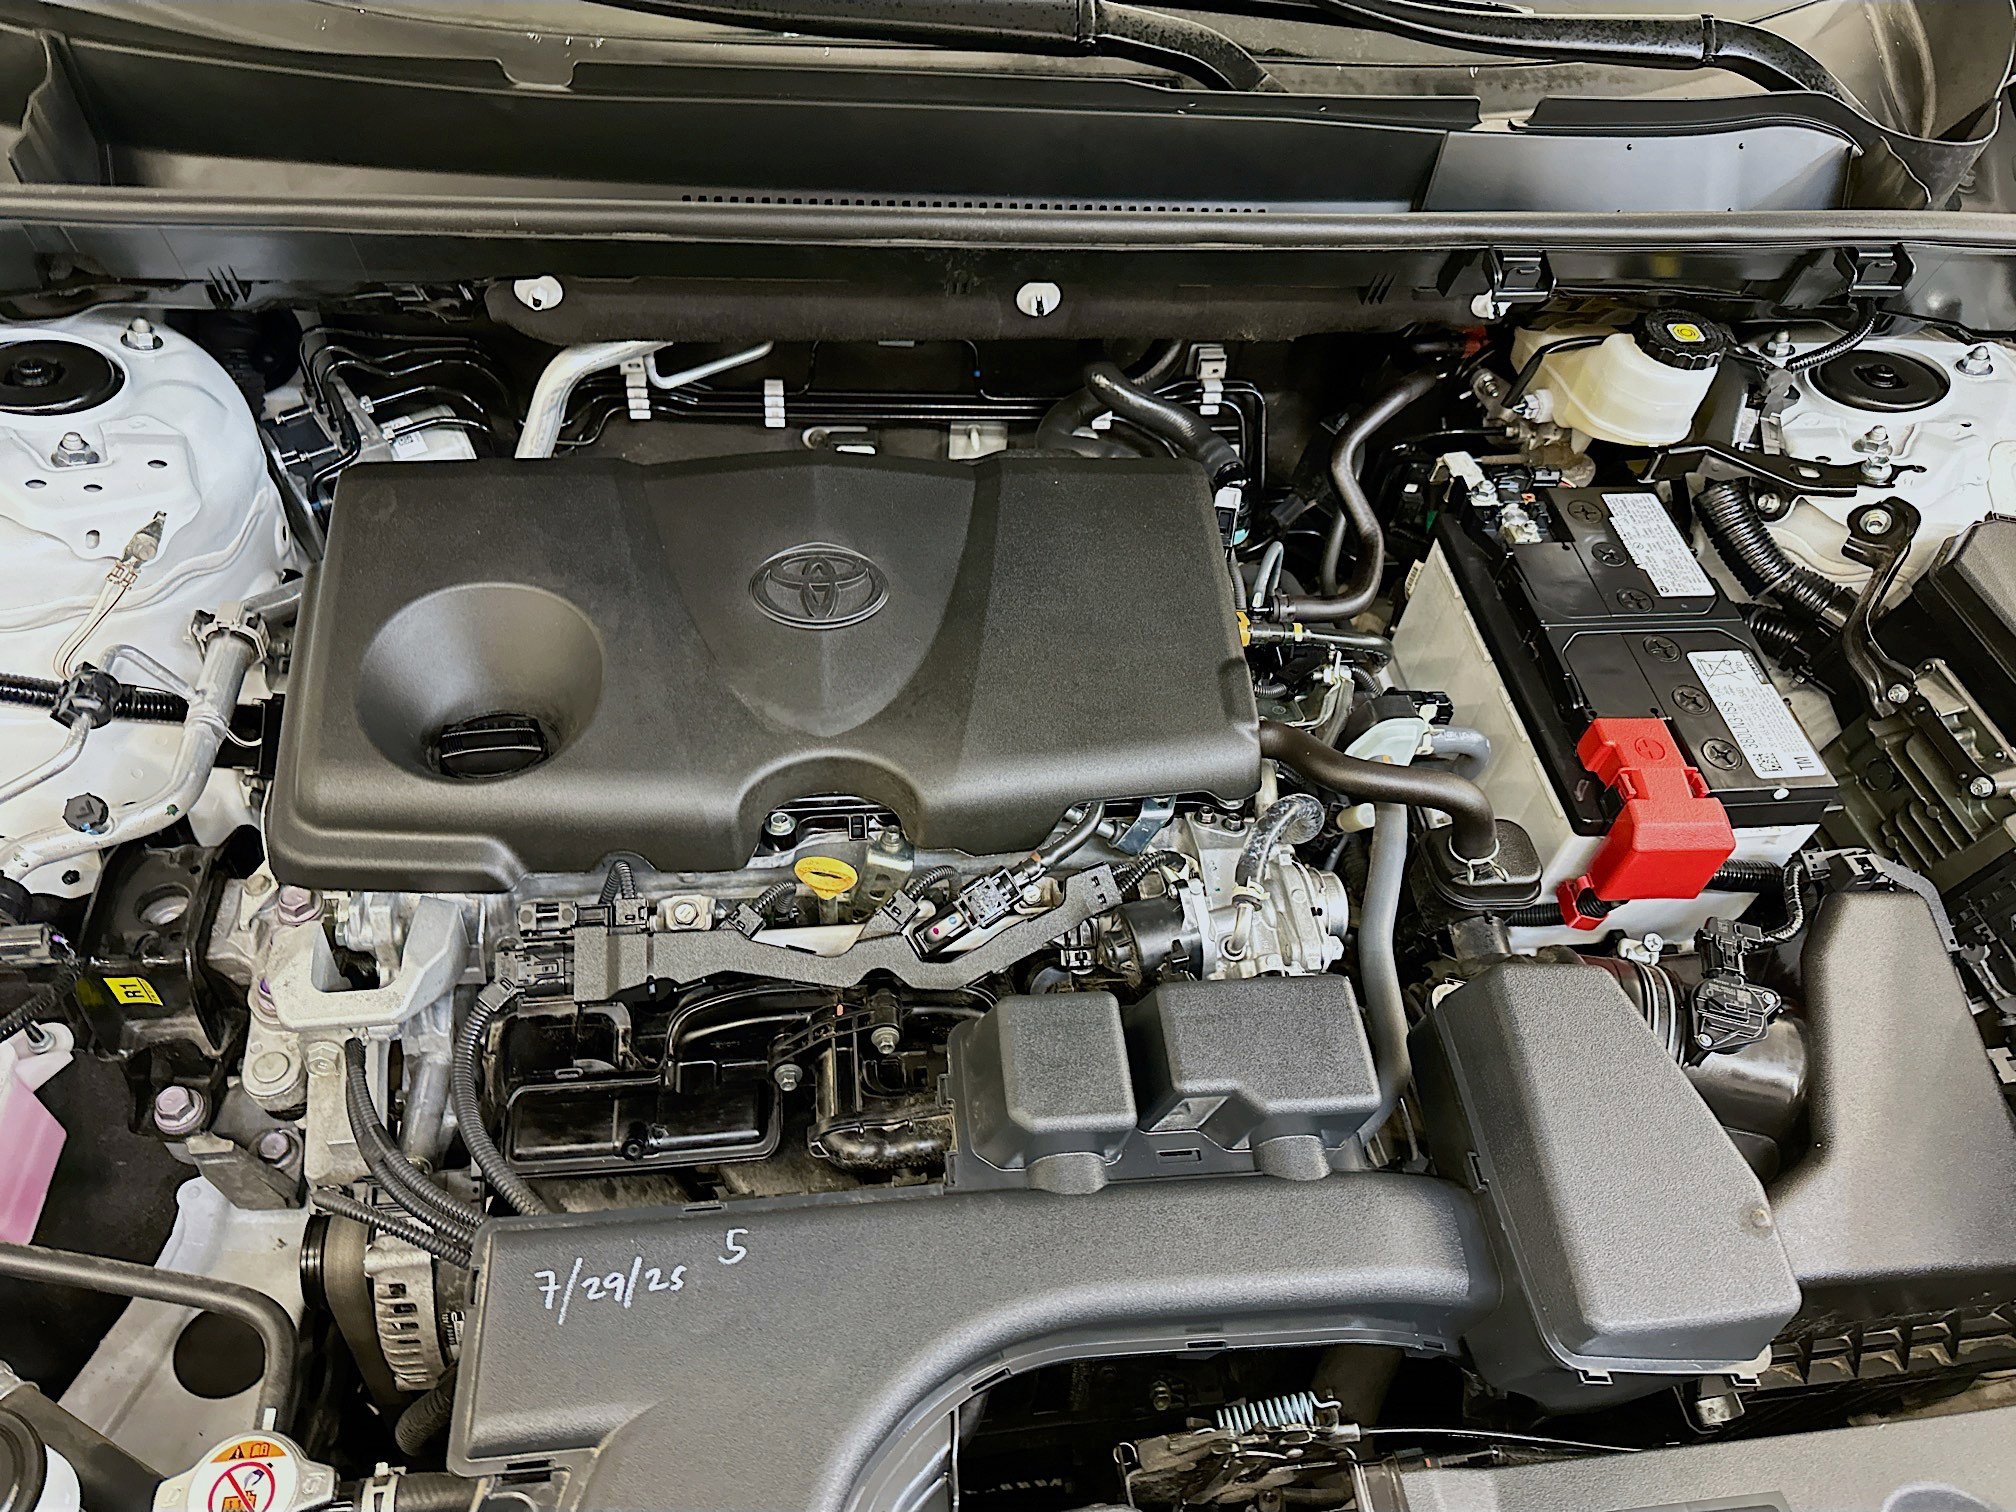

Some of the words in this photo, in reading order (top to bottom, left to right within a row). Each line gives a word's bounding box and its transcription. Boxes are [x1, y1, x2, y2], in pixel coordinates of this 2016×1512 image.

[1793, 755, 1815, 770] TM
[119, 984, 145, 998] R1
[718, 1228, 749, 1265] 5
[534, 1256, 688, 1326] 7/29/25
